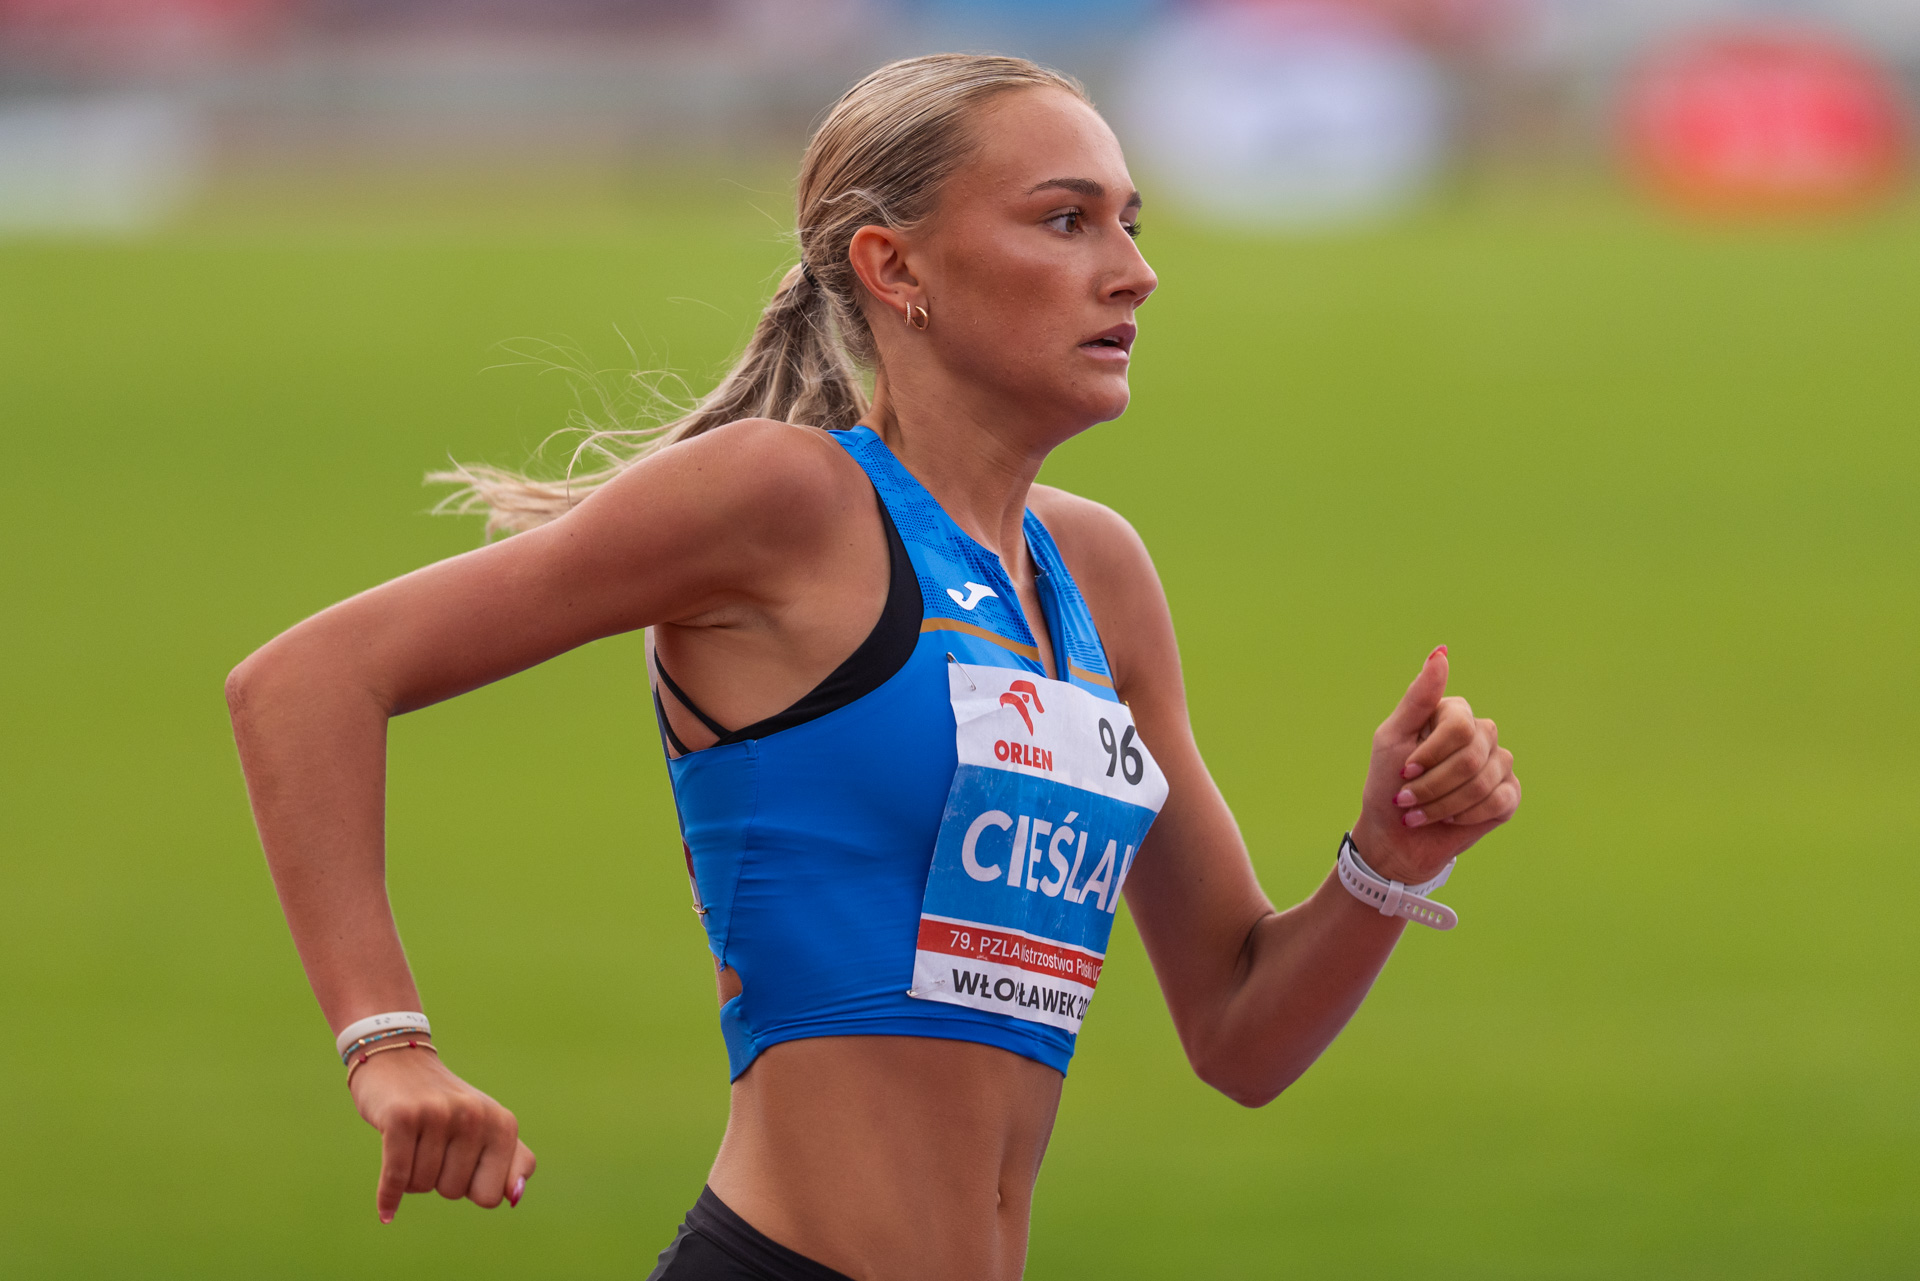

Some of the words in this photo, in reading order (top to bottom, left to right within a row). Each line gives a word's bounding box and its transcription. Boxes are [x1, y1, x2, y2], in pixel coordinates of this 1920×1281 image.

[994, 739, 1053, 772] ORLEN
[1098, 717, 1144, 786] 96
[950, 930, 975, 952] 79.
[980, 936, 1020, 959] PZLA
[1076, 996, 1091, 1022] 20
